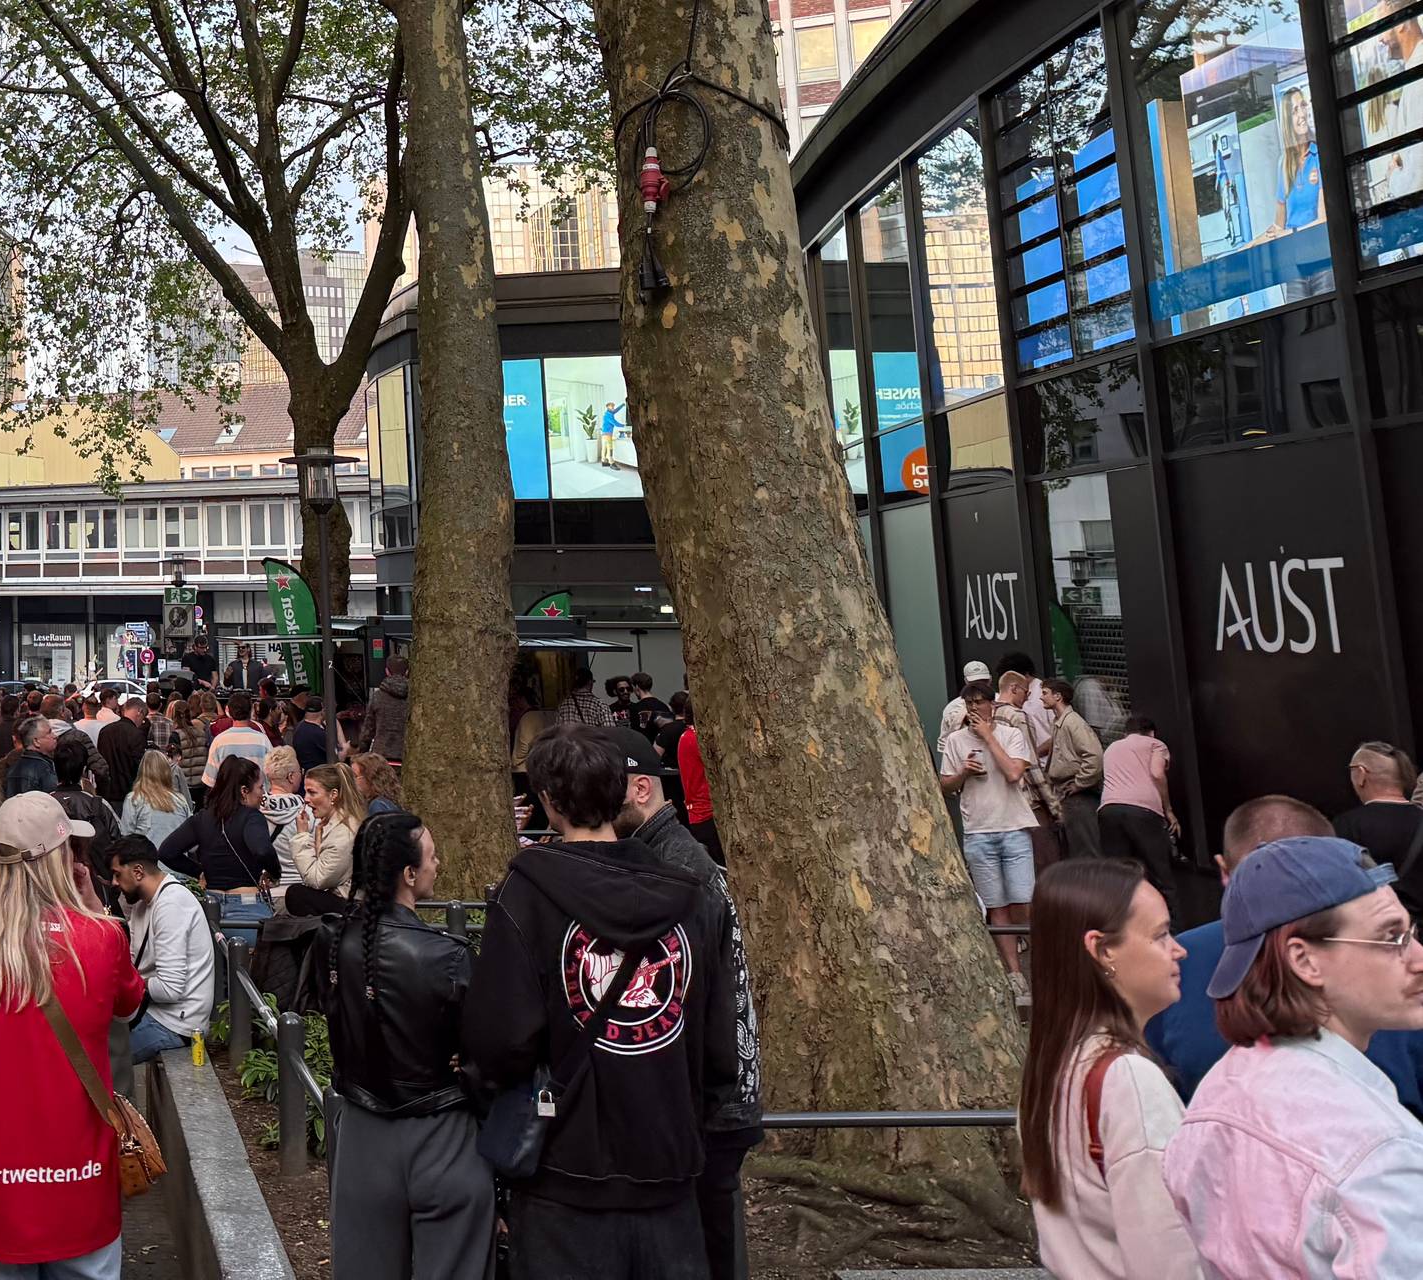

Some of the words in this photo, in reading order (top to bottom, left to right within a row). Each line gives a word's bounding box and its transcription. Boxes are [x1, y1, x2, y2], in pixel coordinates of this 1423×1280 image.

[33, 633, 72, 641] LeseRaum
[280, 596, 309, 685] Heinken
[965, 572, 1018, 641] AUST
[1216, 556, 1345, 654] AUST
